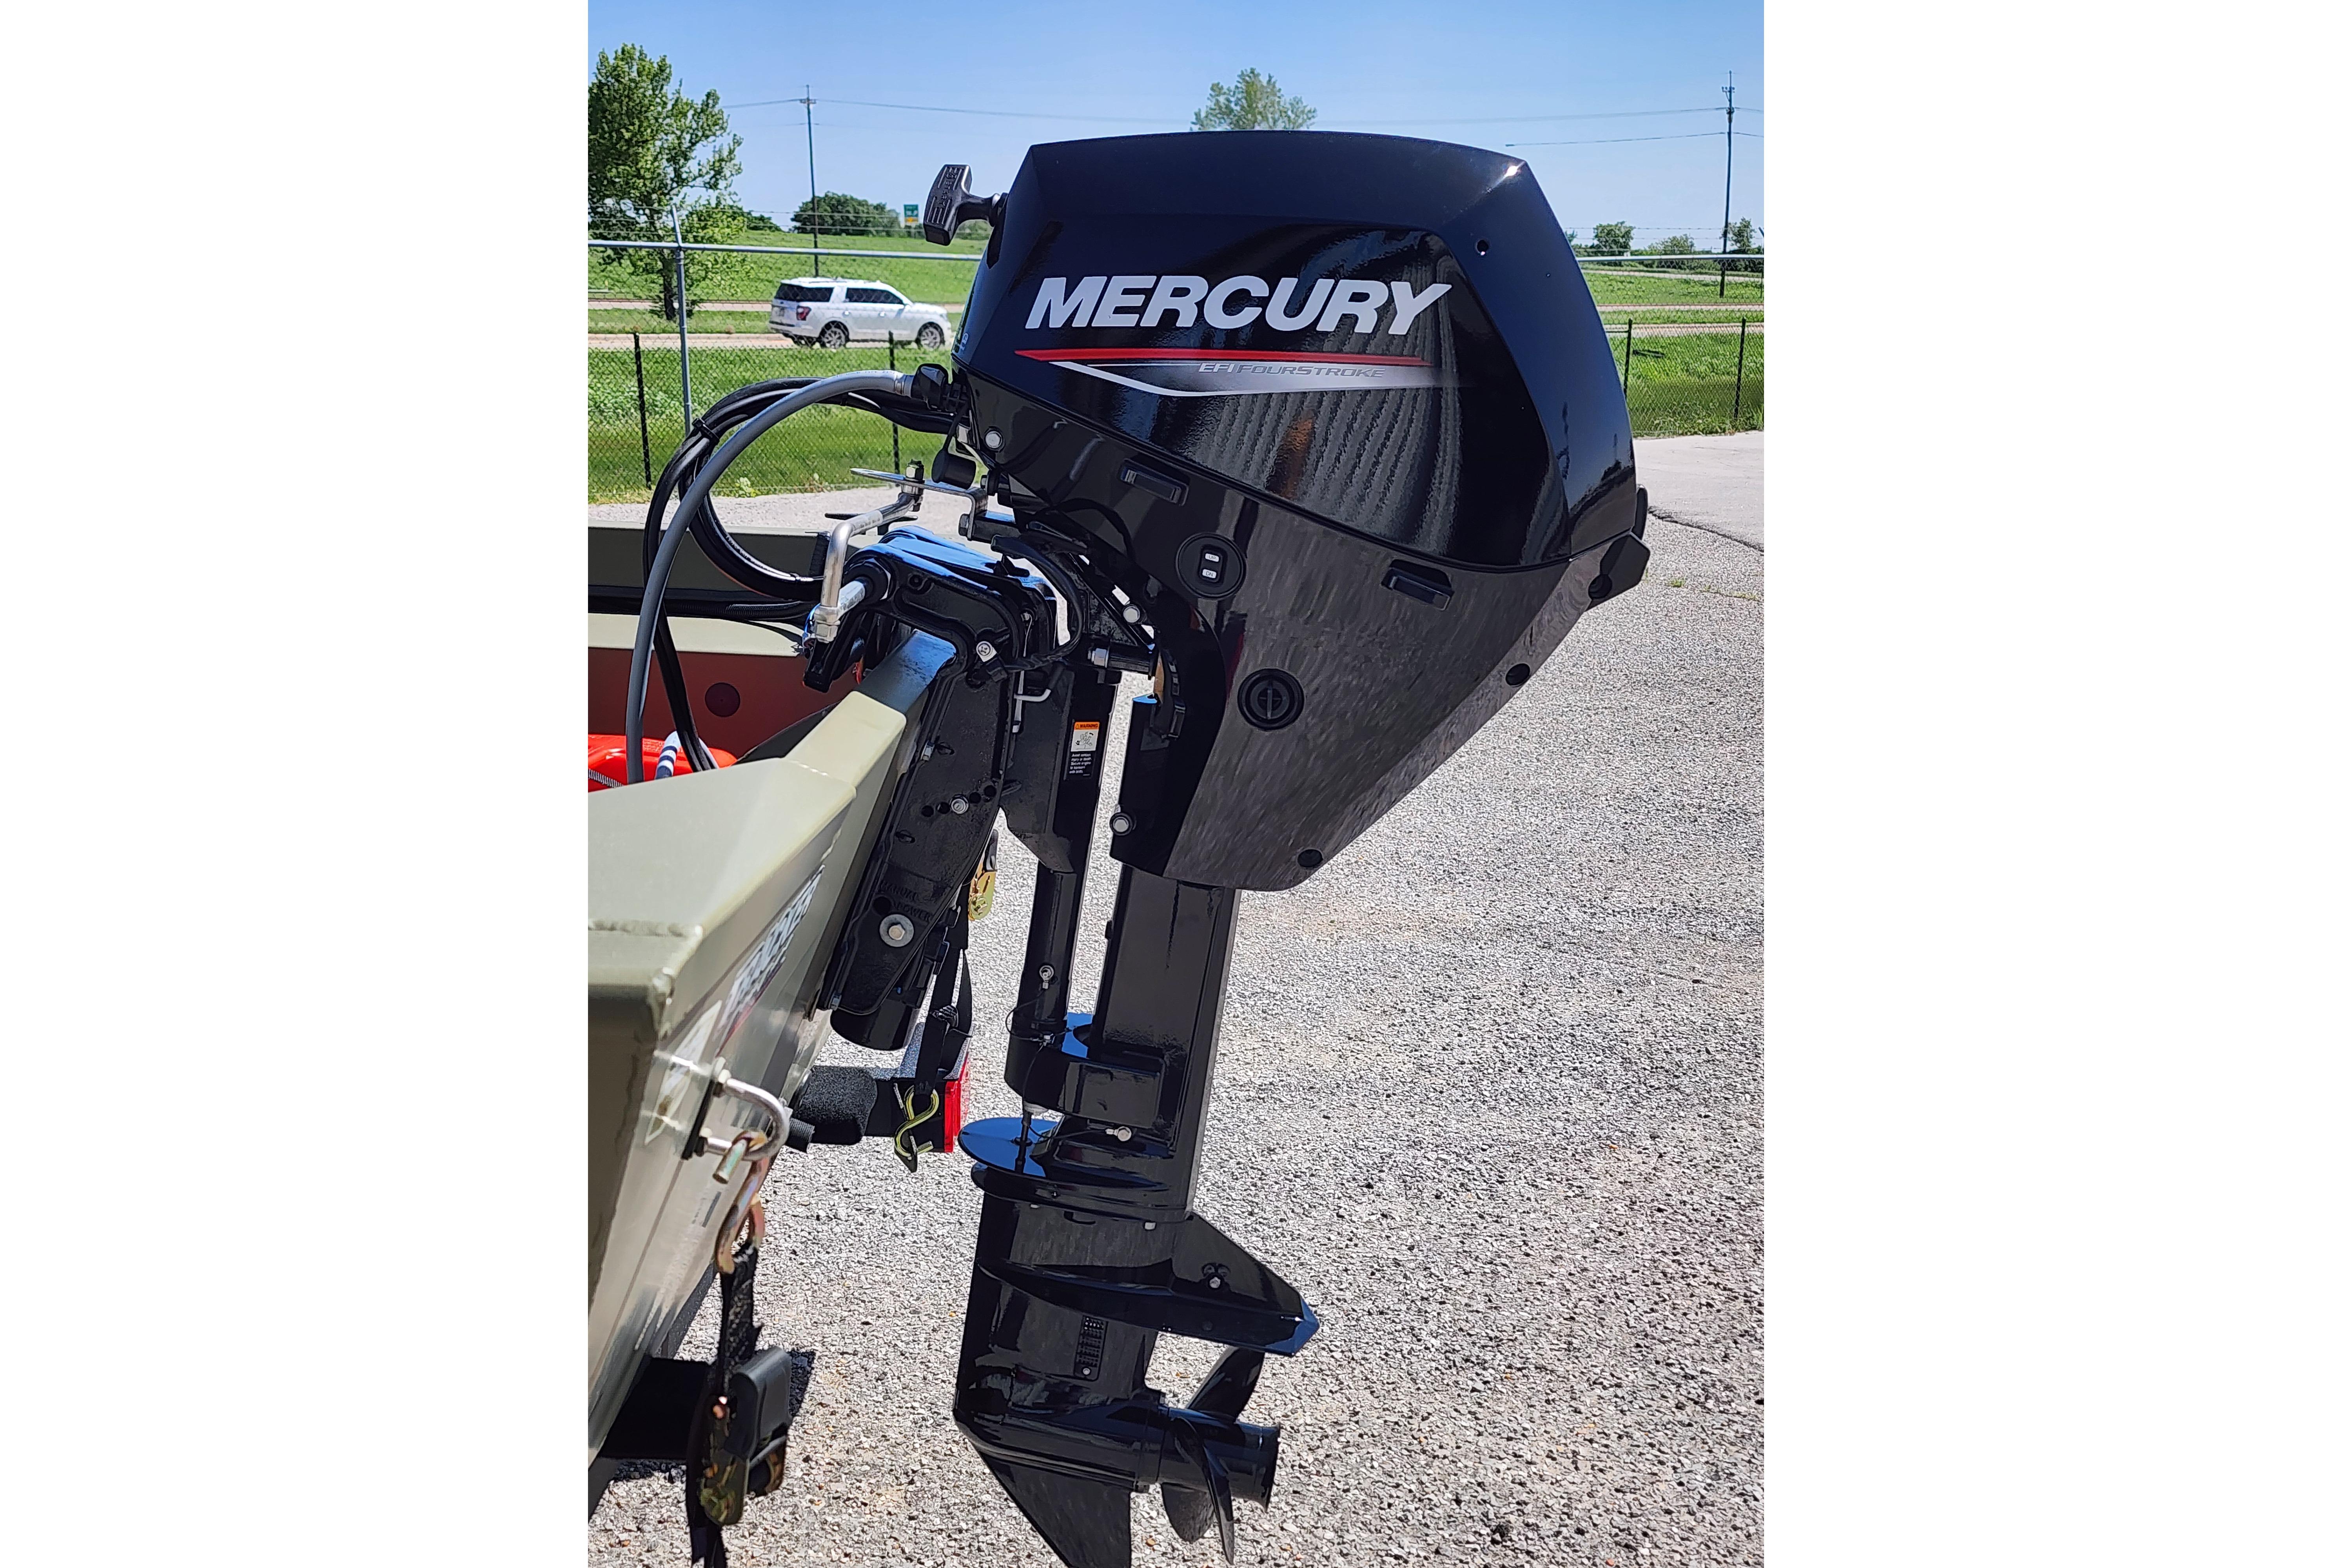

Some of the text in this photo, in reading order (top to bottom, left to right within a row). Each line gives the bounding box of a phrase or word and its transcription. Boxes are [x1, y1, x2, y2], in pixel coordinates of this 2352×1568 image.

[1025, 275, 1452, 334] MERCURY
[1198, 363, 1387, 377] EFI FOURSTROKE
